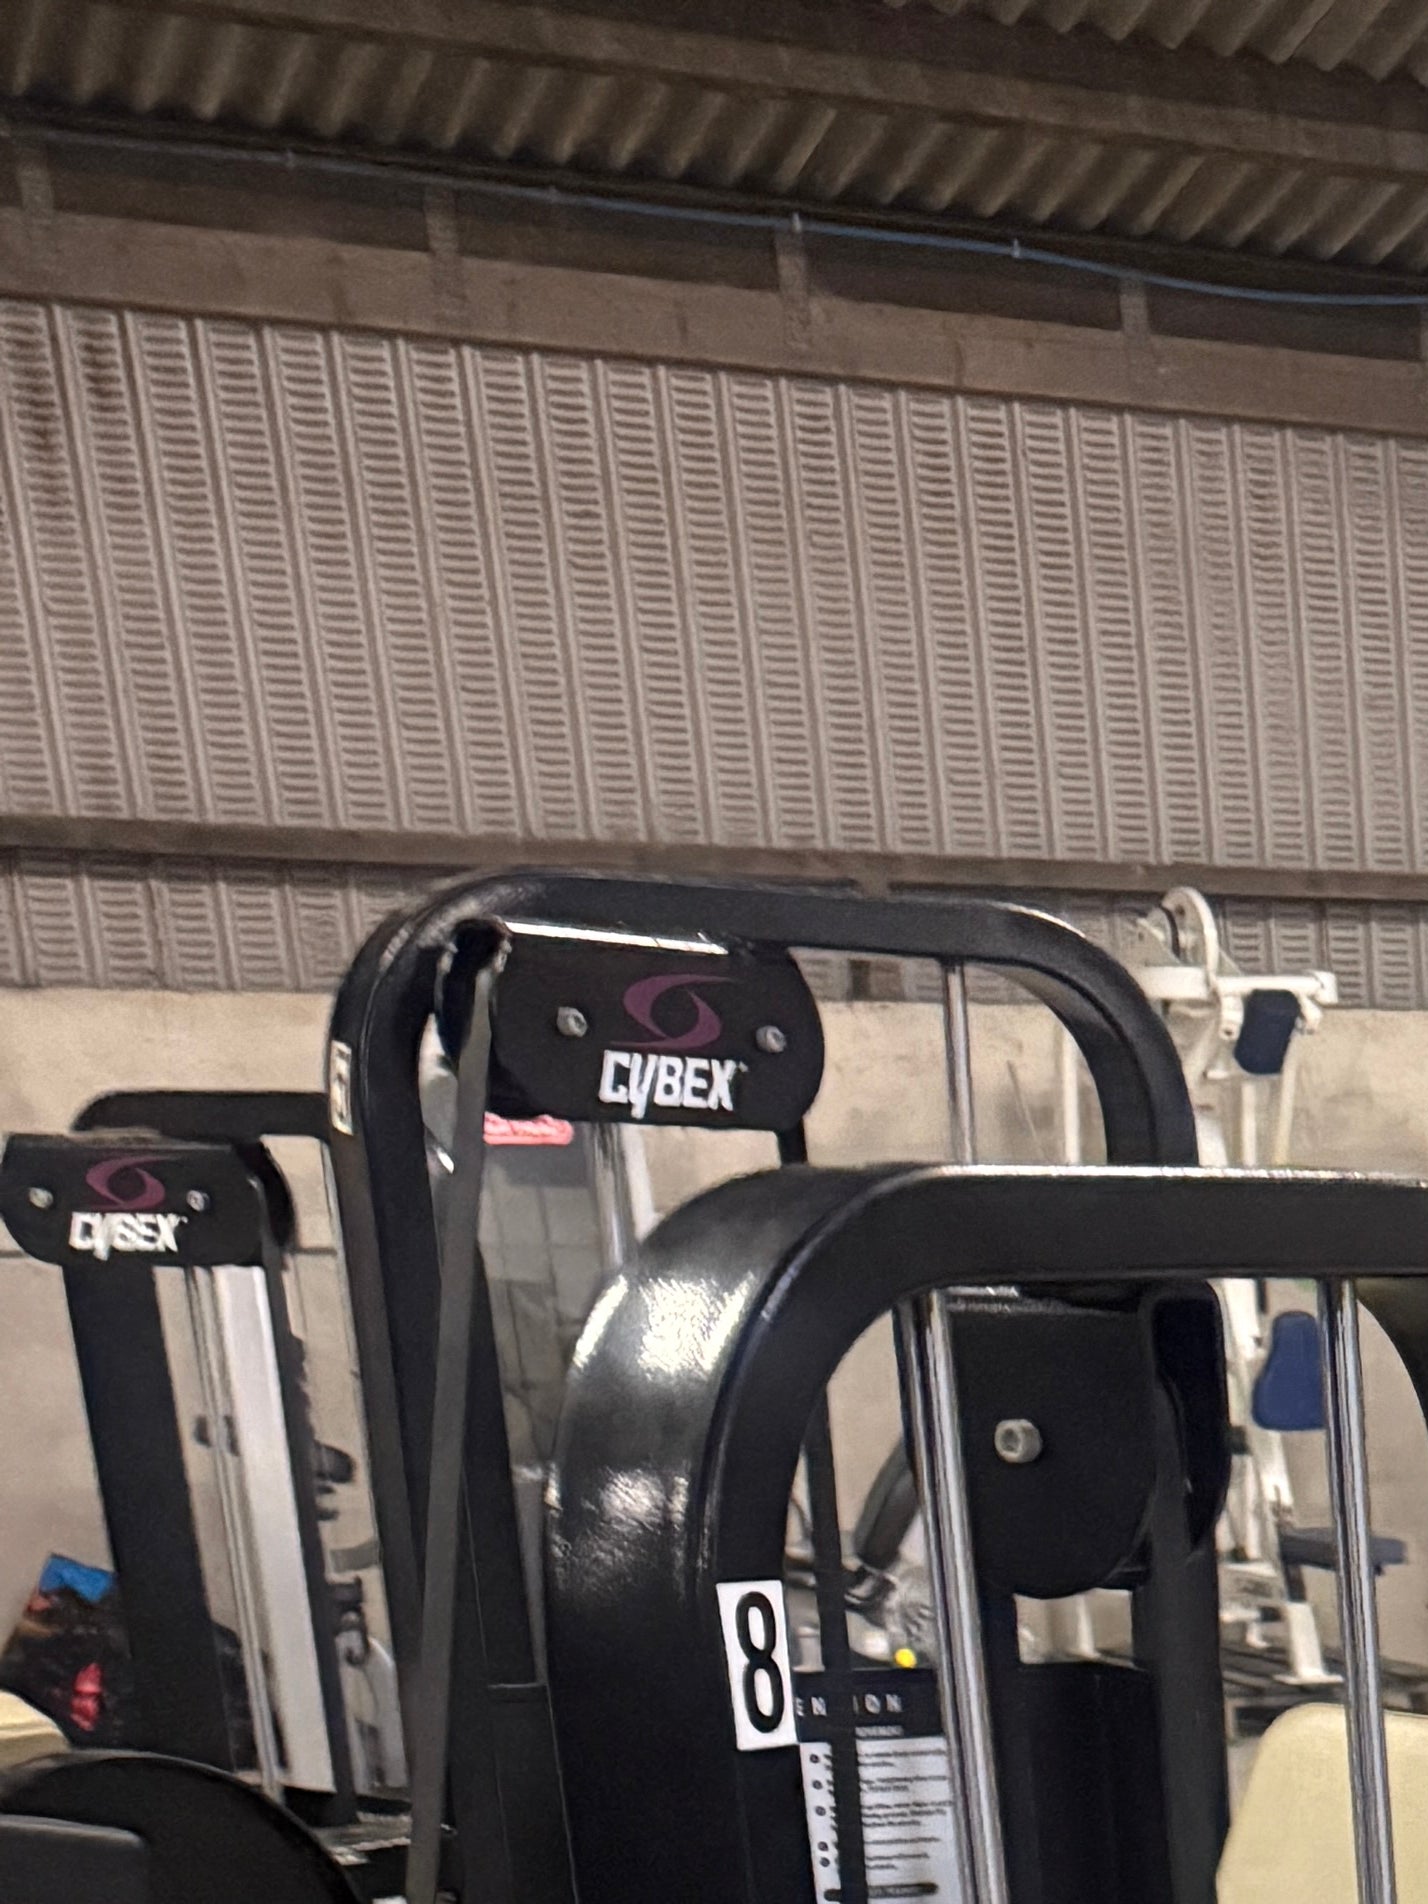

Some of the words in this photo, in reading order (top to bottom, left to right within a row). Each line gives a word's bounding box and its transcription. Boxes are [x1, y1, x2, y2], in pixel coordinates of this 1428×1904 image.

[599, 1049, 737, 1119] CYBEX
[68, 1211, 179, 1261] CYBEX
[735, 1592, 785, 1733] 8
